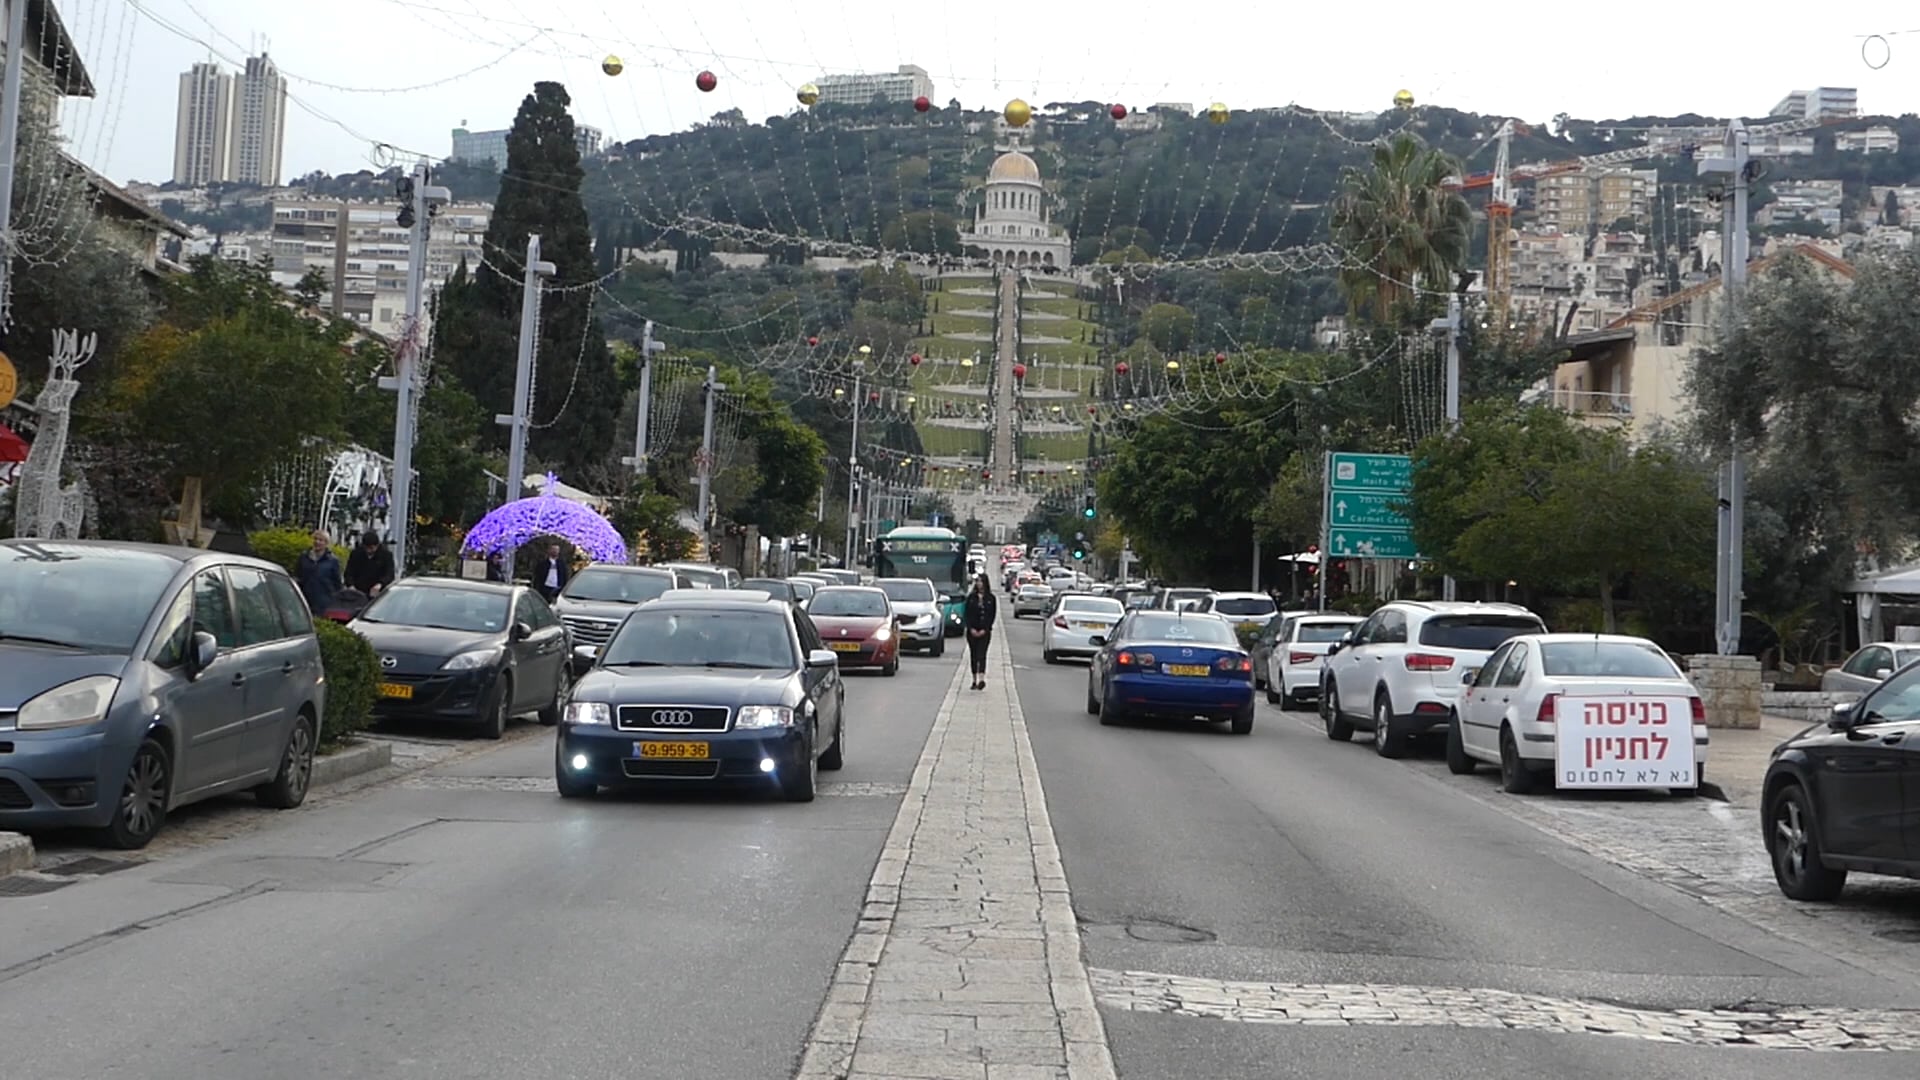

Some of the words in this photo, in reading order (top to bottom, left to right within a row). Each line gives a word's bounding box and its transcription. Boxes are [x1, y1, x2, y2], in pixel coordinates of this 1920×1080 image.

[1387, 516, 1410, 524] Cent
[1584, 702, 1667, 725] כניסה
[1585, 732, 1669, 768] לחניון
[1566, 769, 1626, 783] לחסום
[1637, 769, 1659, 782] לא
[1670, 771, 1689, 782] נא
